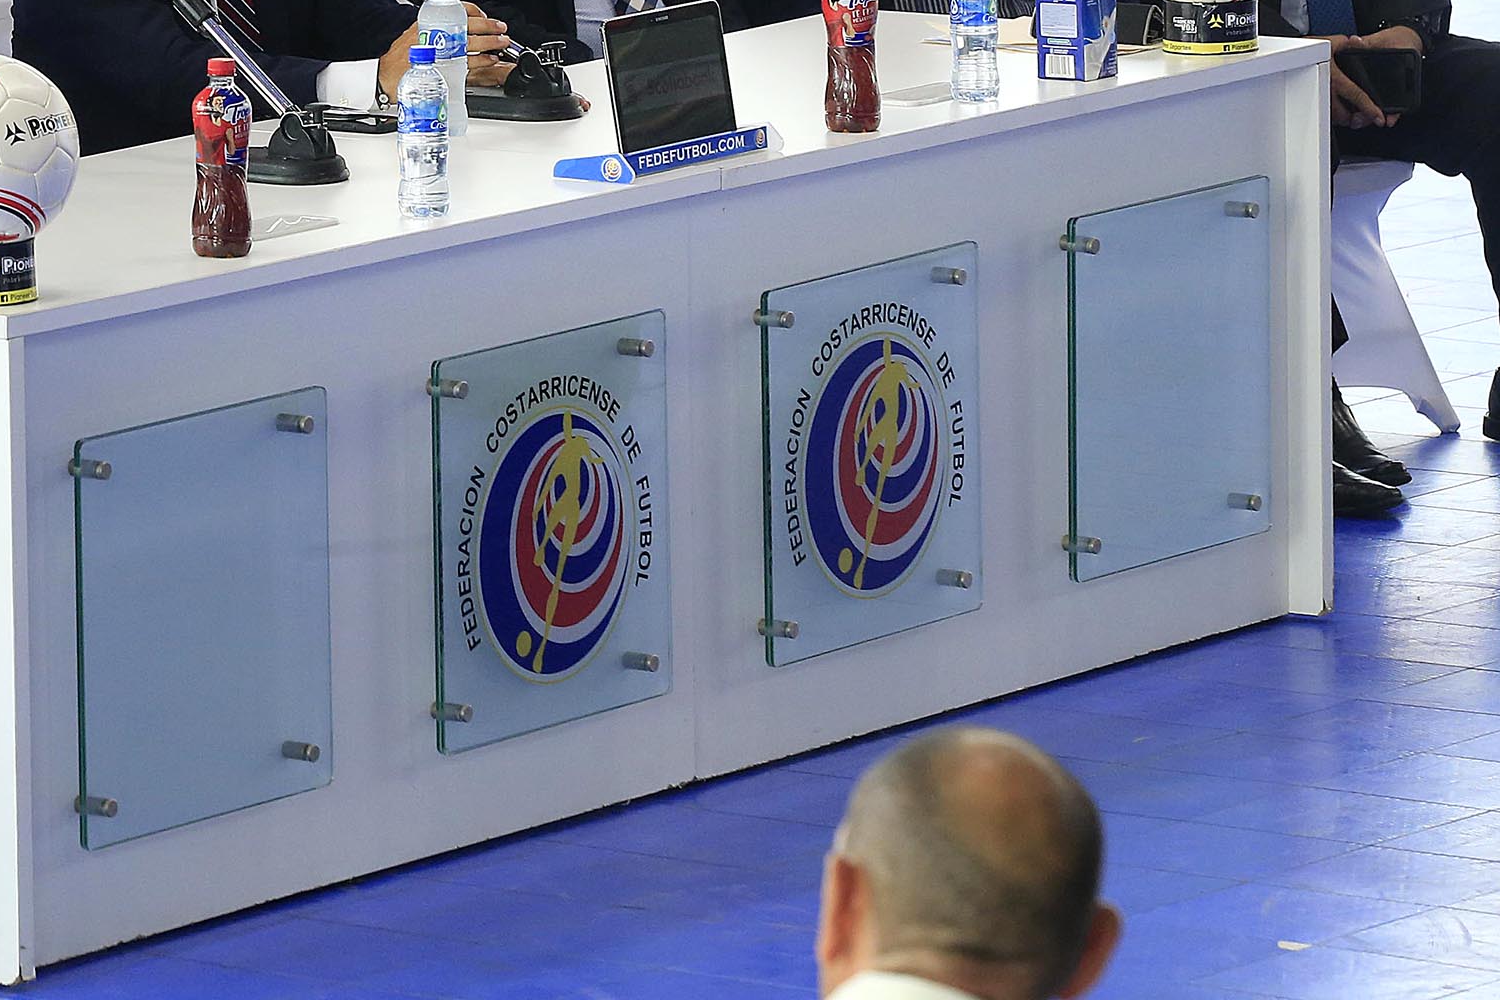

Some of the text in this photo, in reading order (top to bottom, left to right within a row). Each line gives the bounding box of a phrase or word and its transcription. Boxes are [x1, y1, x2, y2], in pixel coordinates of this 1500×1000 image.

[1227, 13, 1256, 27] PIONE
[638, 135, 745, 170] FEDEFUTBOL.COM
[3, 257, 35, 273] PIONE
[784, 302, 965, 567] FEDERACION COSTARRICENSE DE FUTBOL
[457, 374, 653, 651] FEDERACION COSTARRICENSE DE FUTBOL
